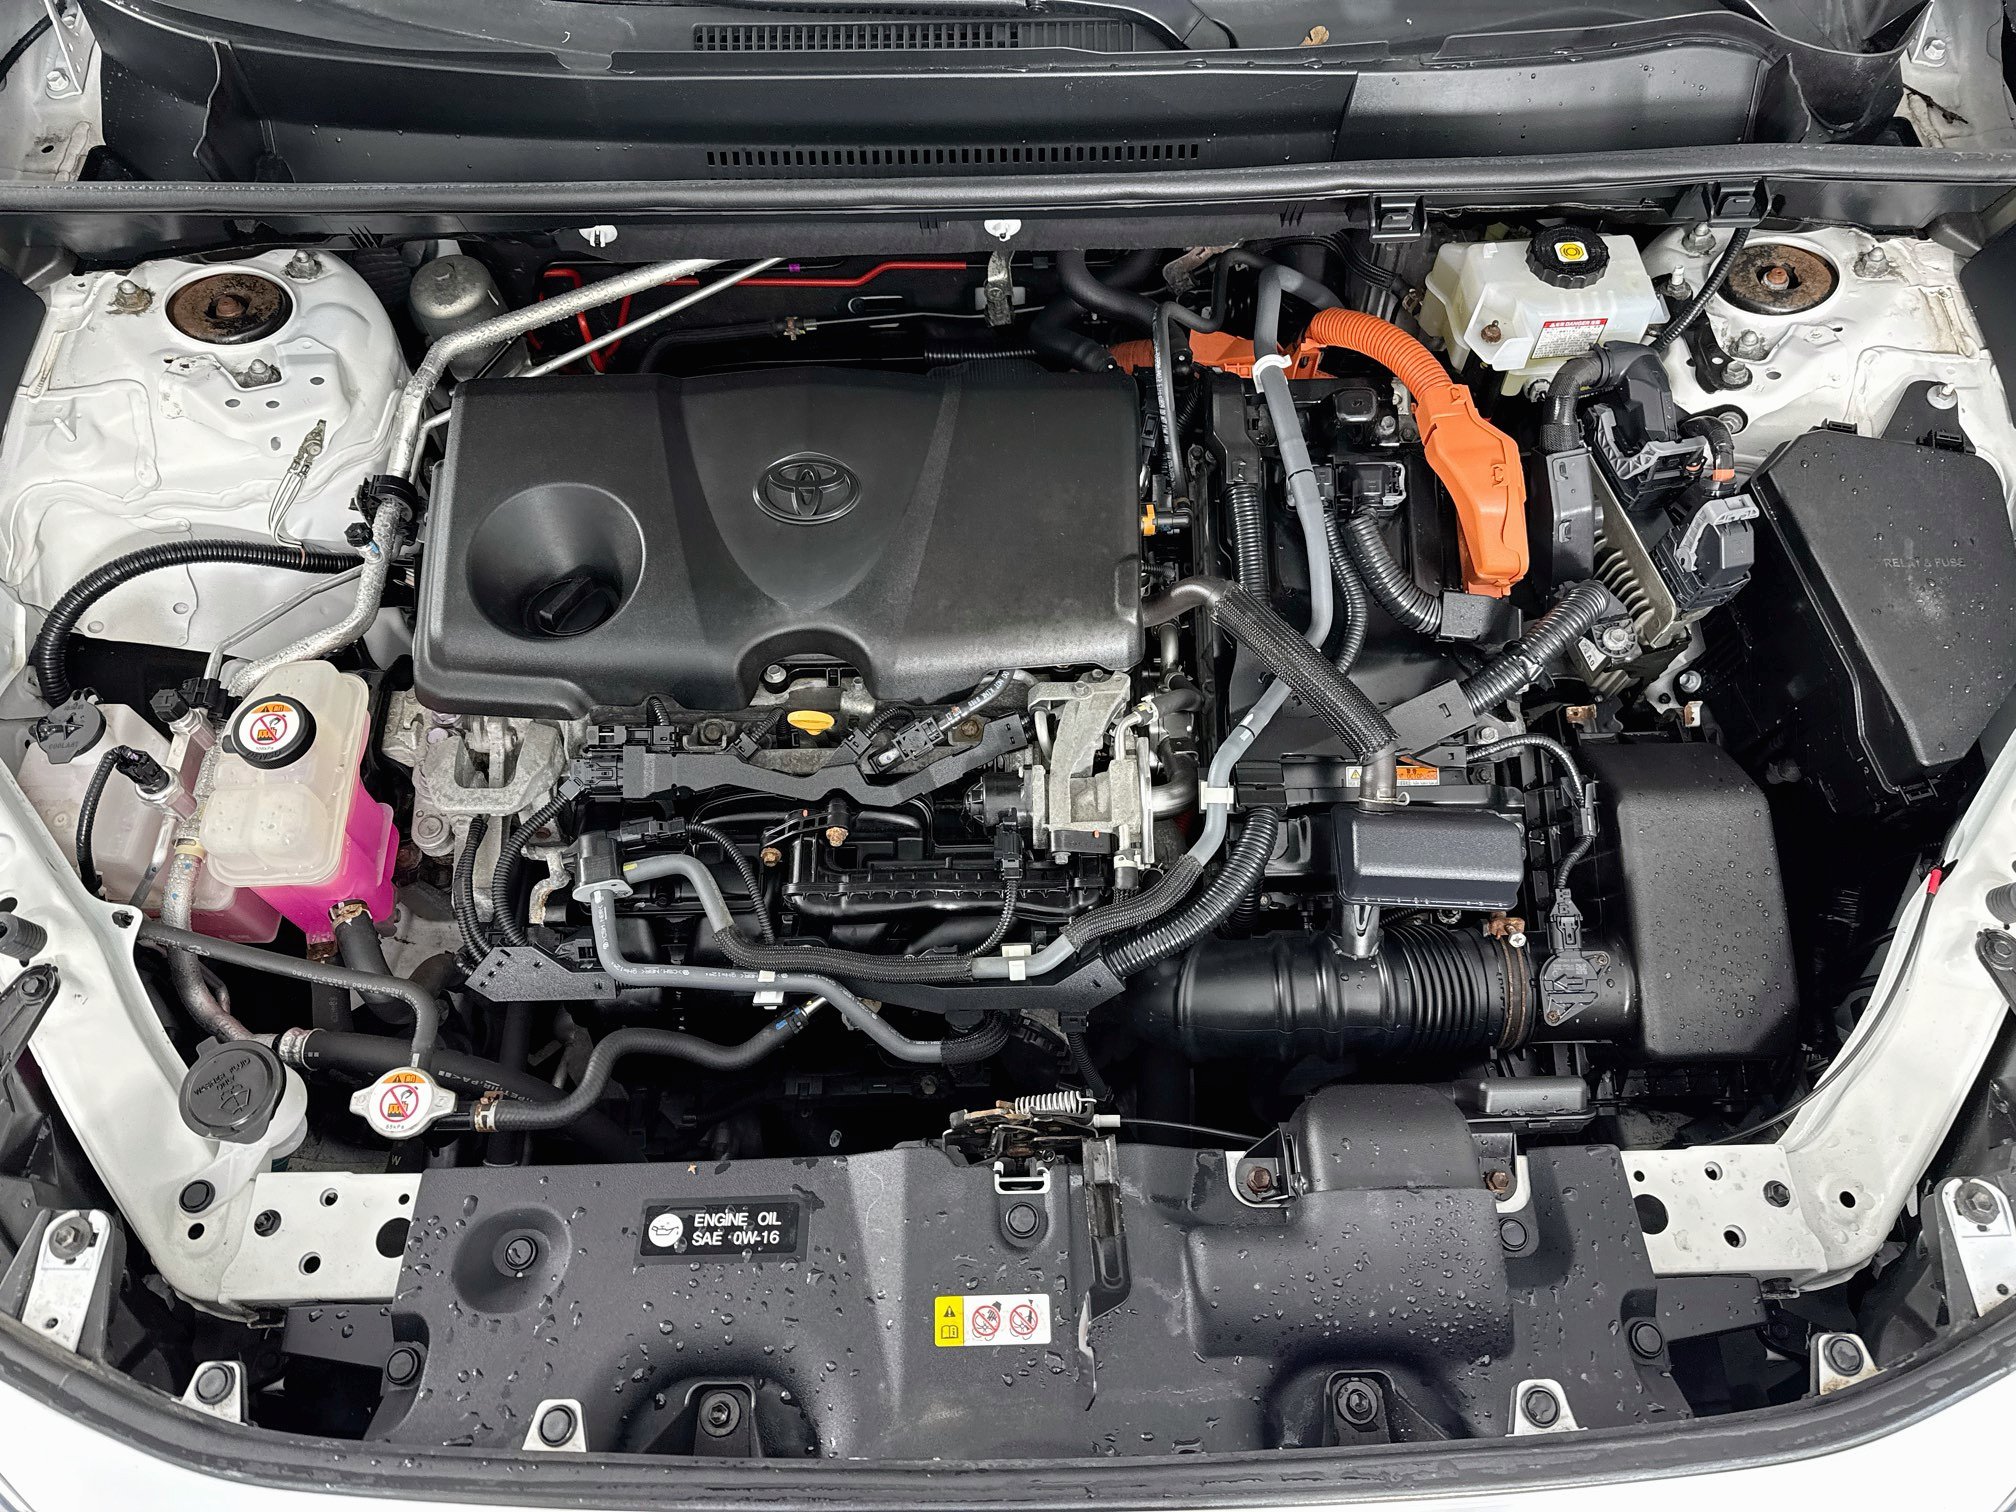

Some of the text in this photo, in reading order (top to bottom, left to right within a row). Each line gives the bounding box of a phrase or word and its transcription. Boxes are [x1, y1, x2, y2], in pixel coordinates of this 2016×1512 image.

[1935, 557, 1966, 567] FUSE
[193, 1057, 252, 1096] WASHER FLUID
[694, 1211, 782, 1228] ENGINE OIL
[691, 1230, 780, 1246] SAE 0W-16
